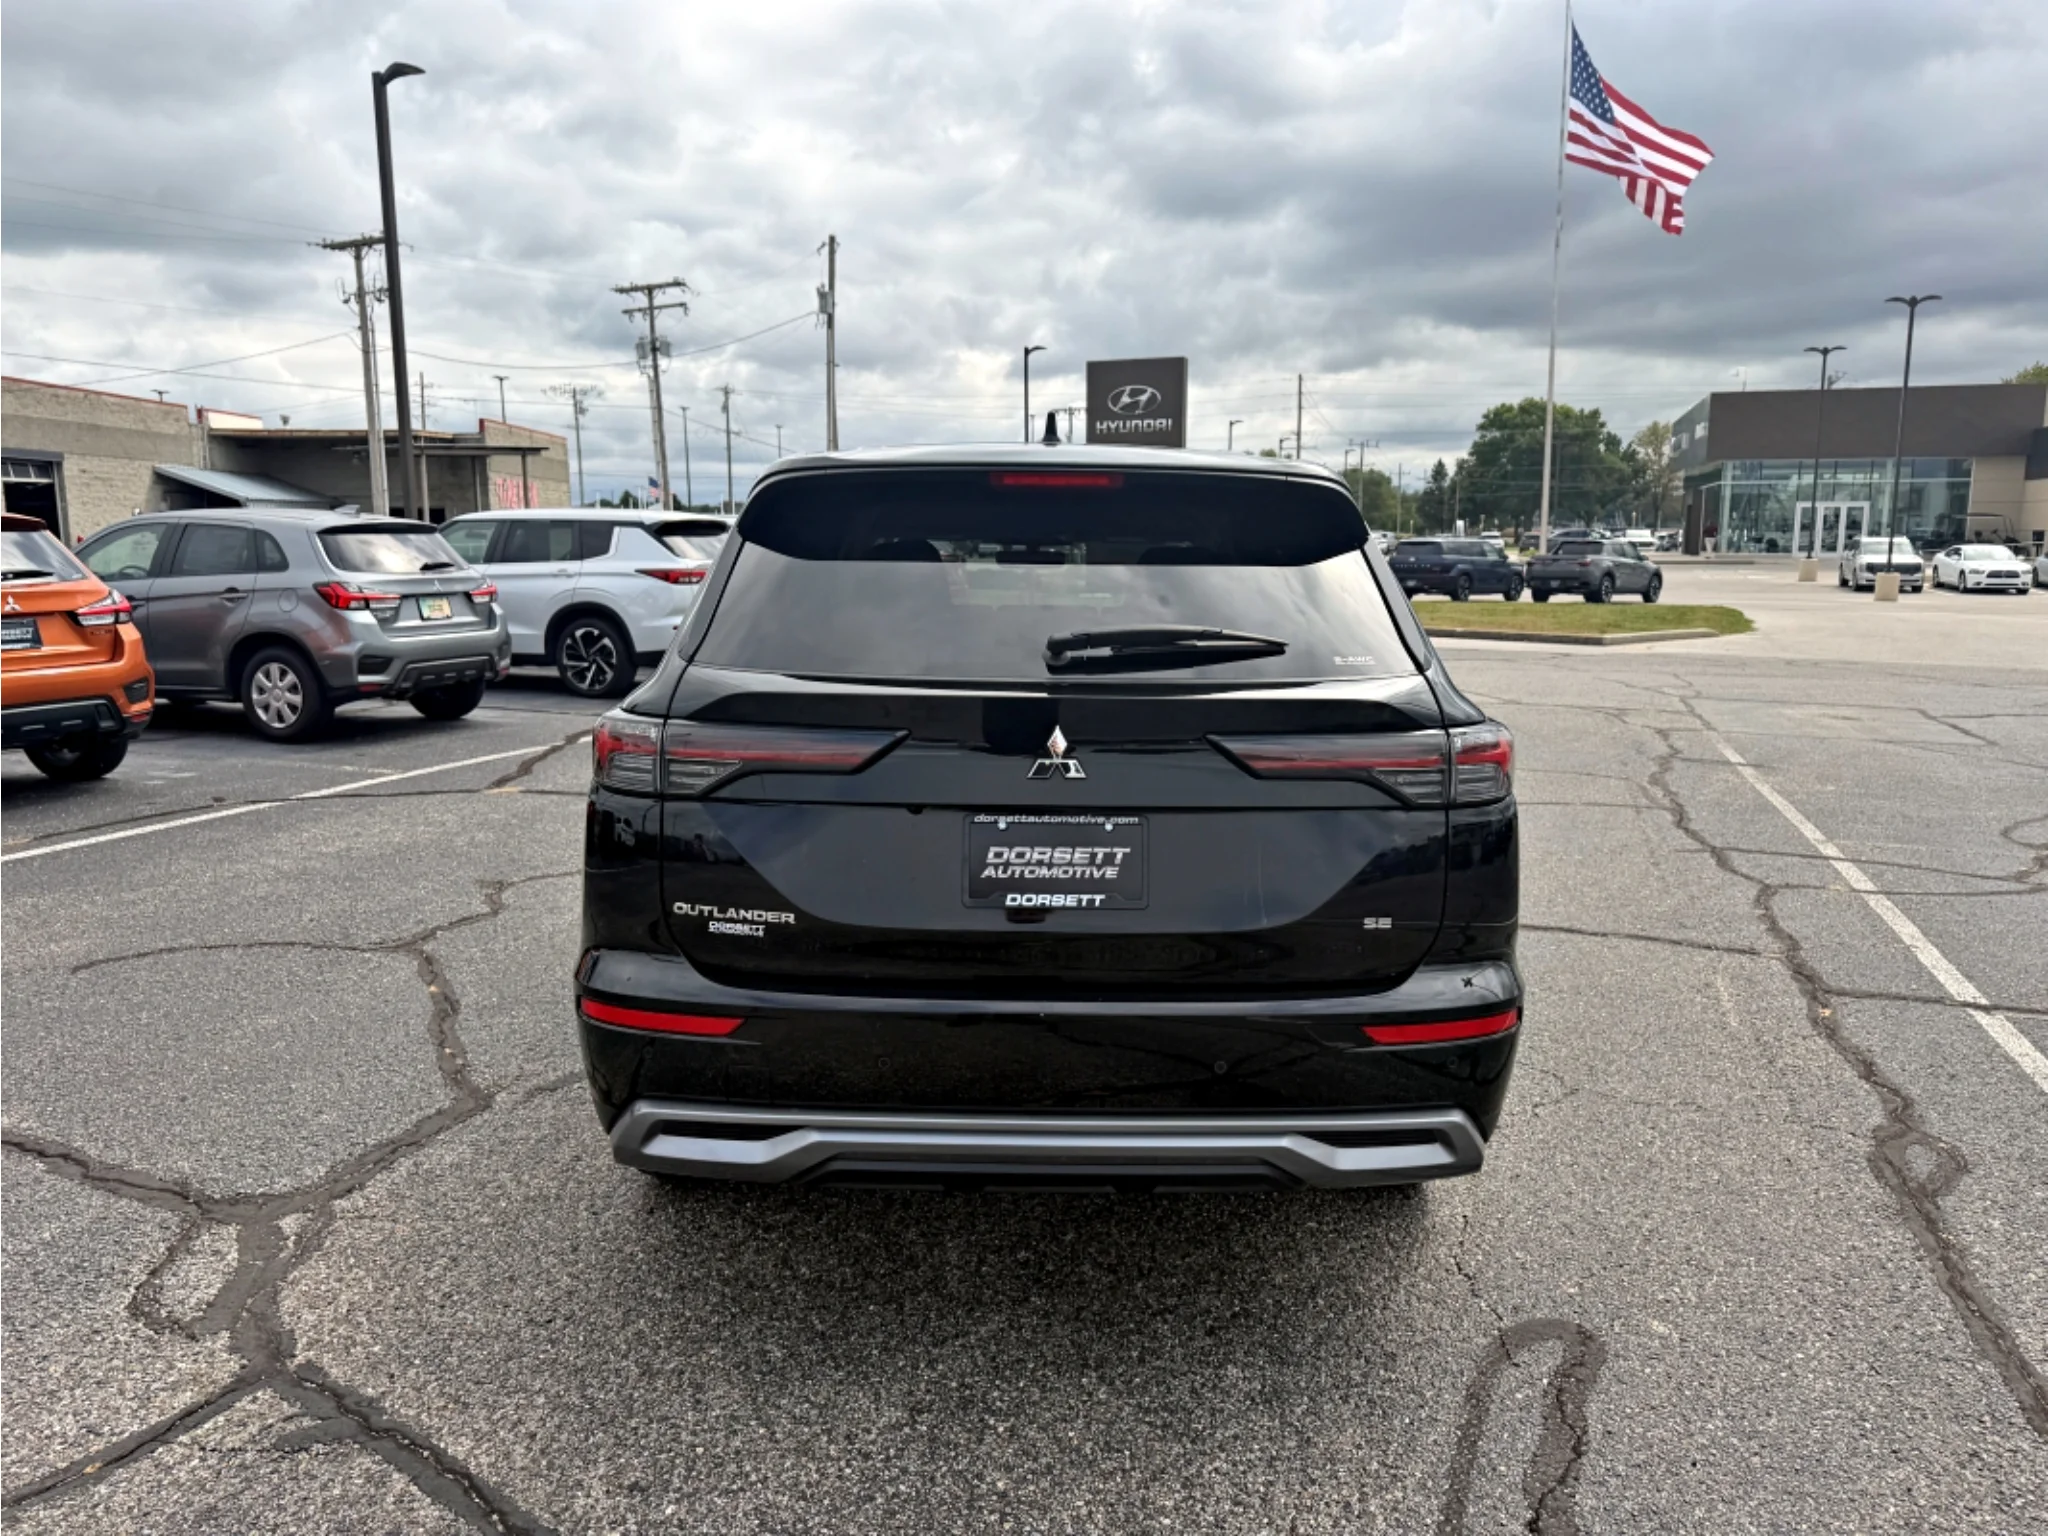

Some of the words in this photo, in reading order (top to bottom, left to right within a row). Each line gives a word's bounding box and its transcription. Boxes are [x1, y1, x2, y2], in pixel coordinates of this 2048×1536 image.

[1096, 418, 1173, 434] HYUNDAI
[974, 814, 1139, 824] dorsettautomotive.com
[986, 846, 1131, 864] DORSETT
[980, 865, 1119, 878] AUTOMOTIVE
[1005, 893, 1106, 907] DORSETT
[673, 902, 796, 923] OUTLANDER
[1363, 917, 1392, 929] SE
